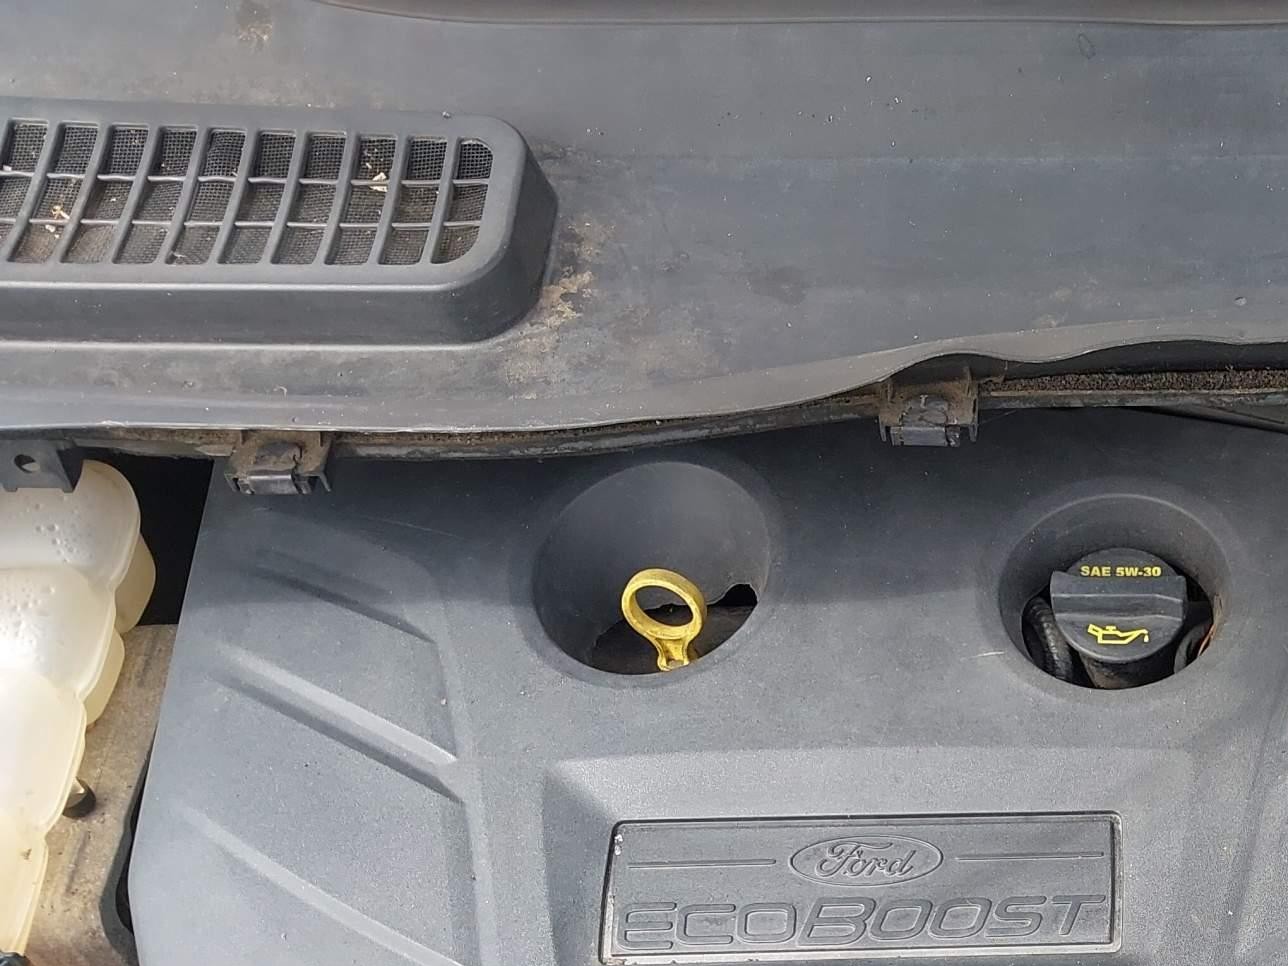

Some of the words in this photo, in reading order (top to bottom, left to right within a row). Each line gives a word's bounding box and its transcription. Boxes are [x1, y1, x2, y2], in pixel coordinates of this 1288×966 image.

[1080, 565, 1111, 577] SAE
[1116, 566, 1162, 577] 5W-30
[816, 840, 917, 879] Ford
